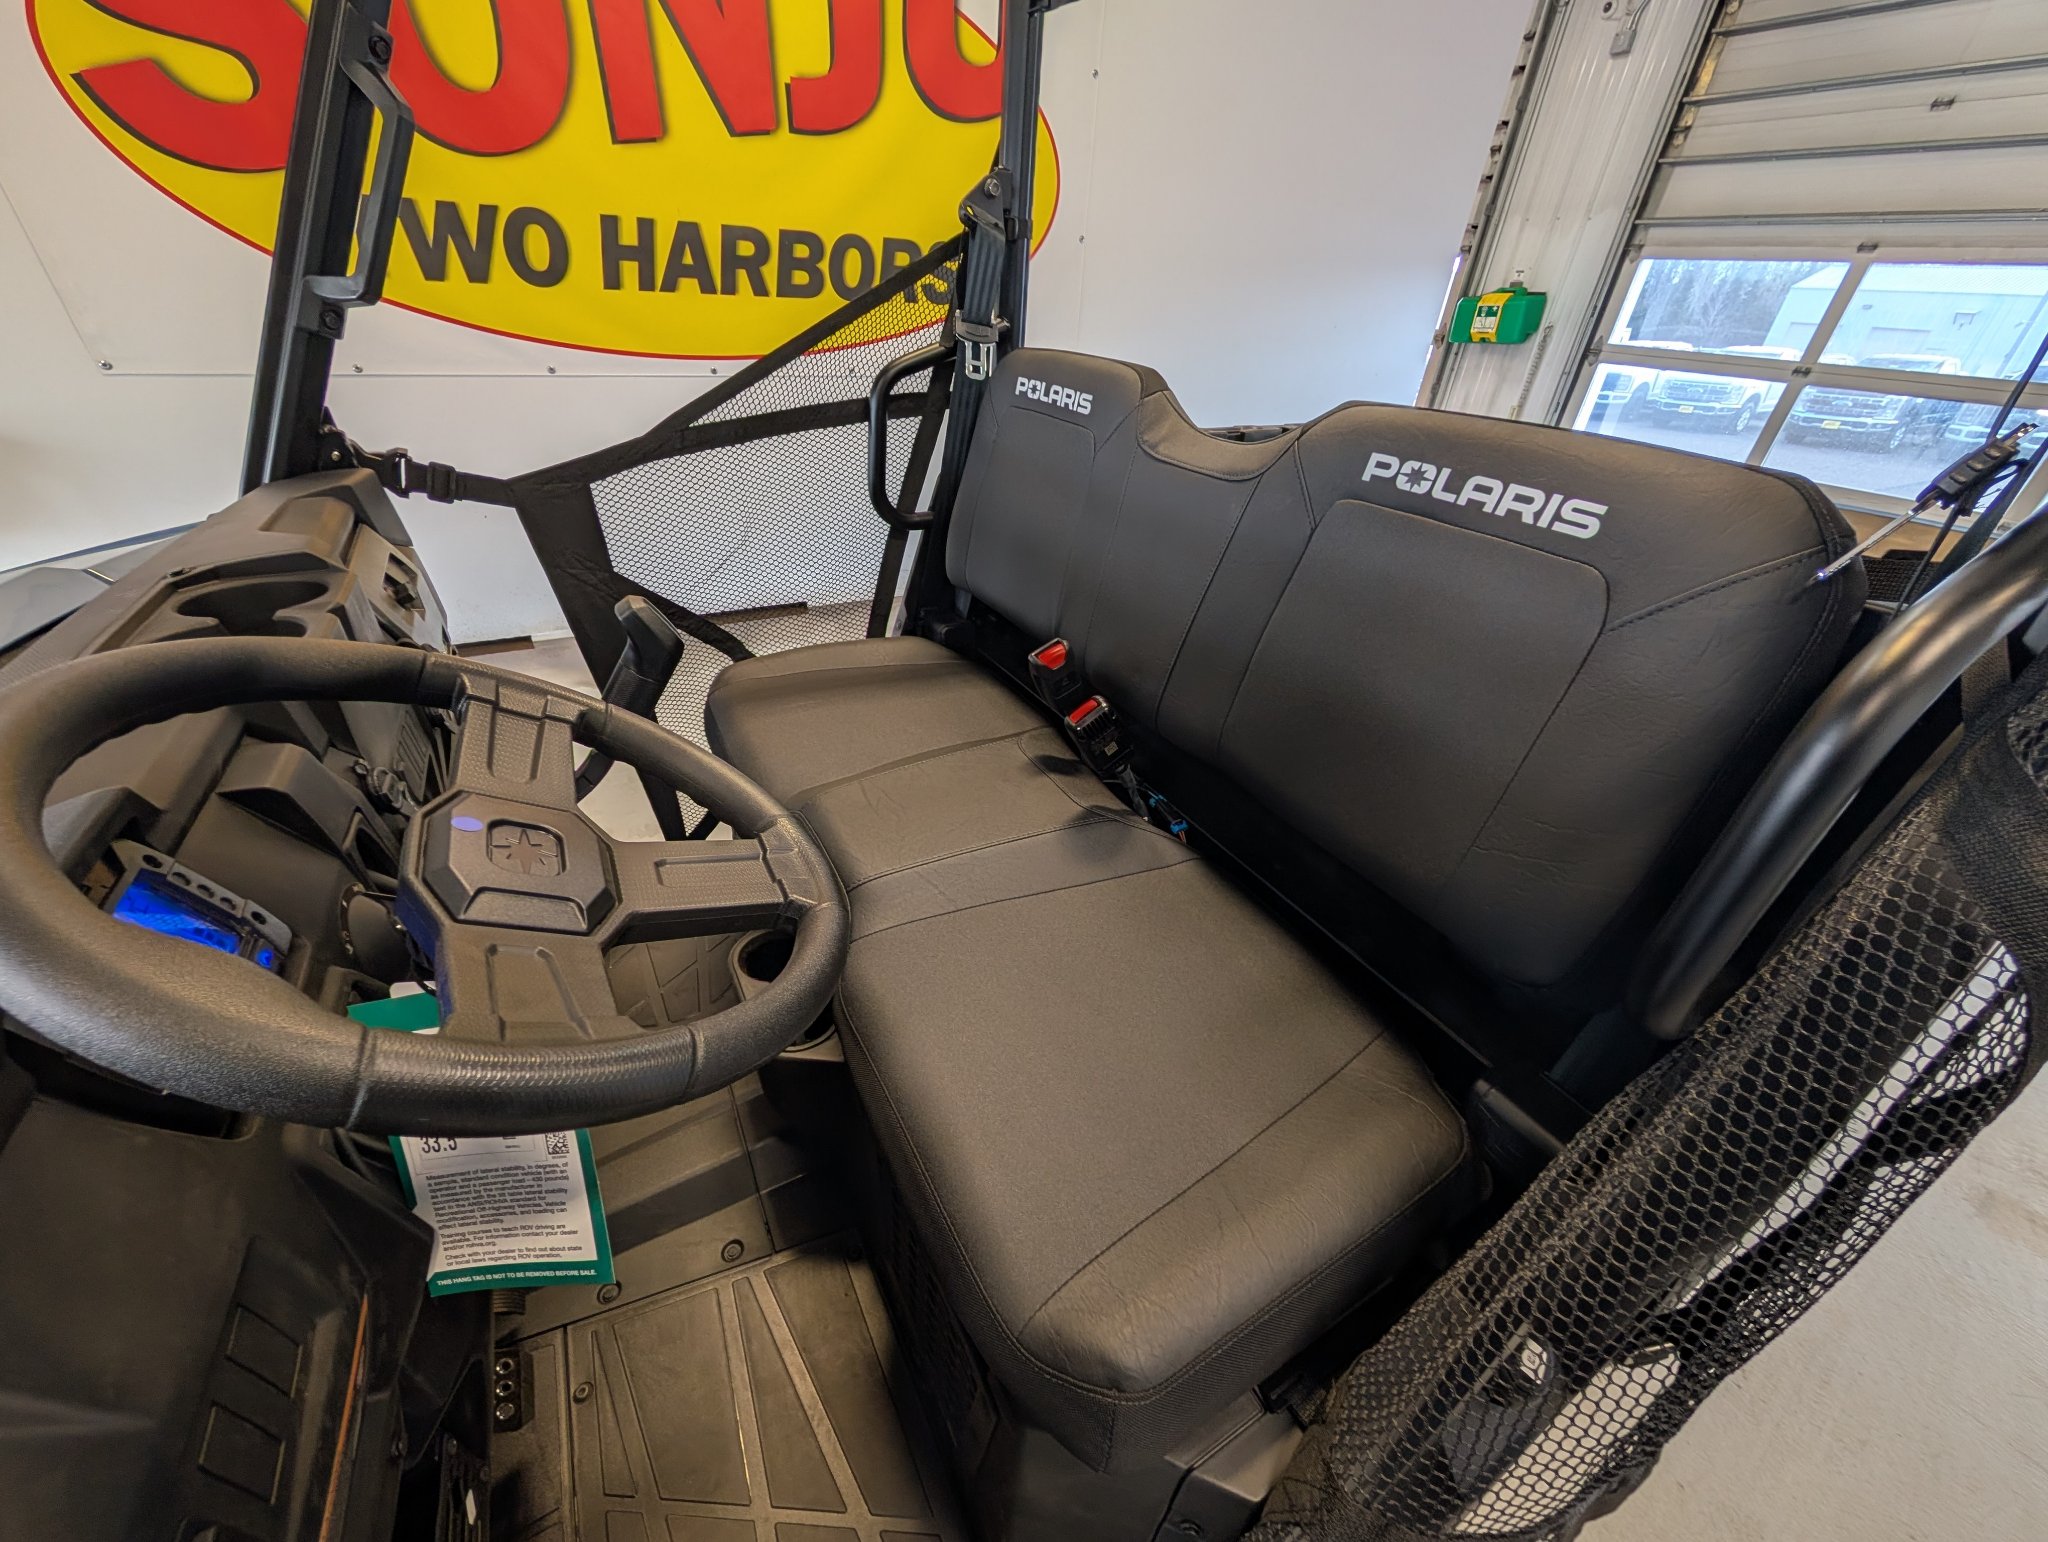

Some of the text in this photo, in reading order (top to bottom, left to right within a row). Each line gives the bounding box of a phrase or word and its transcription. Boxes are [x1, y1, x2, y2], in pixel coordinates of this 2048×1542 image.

[356, 194, 570, 288] WO
[1015, 376, 1094, 415] POLARIS
[1361, 452, 1609, 540] POLARIS
[426, 1170, 471, 1181] Measurement
[490, 1172, 520, 1180] condition
[440, 1189, 472, 1198] measured
[485, 1232, 520, 1240] information
[445, 1253, 466, 1261] Check
[453, 1276, 472, 1284] HANG
